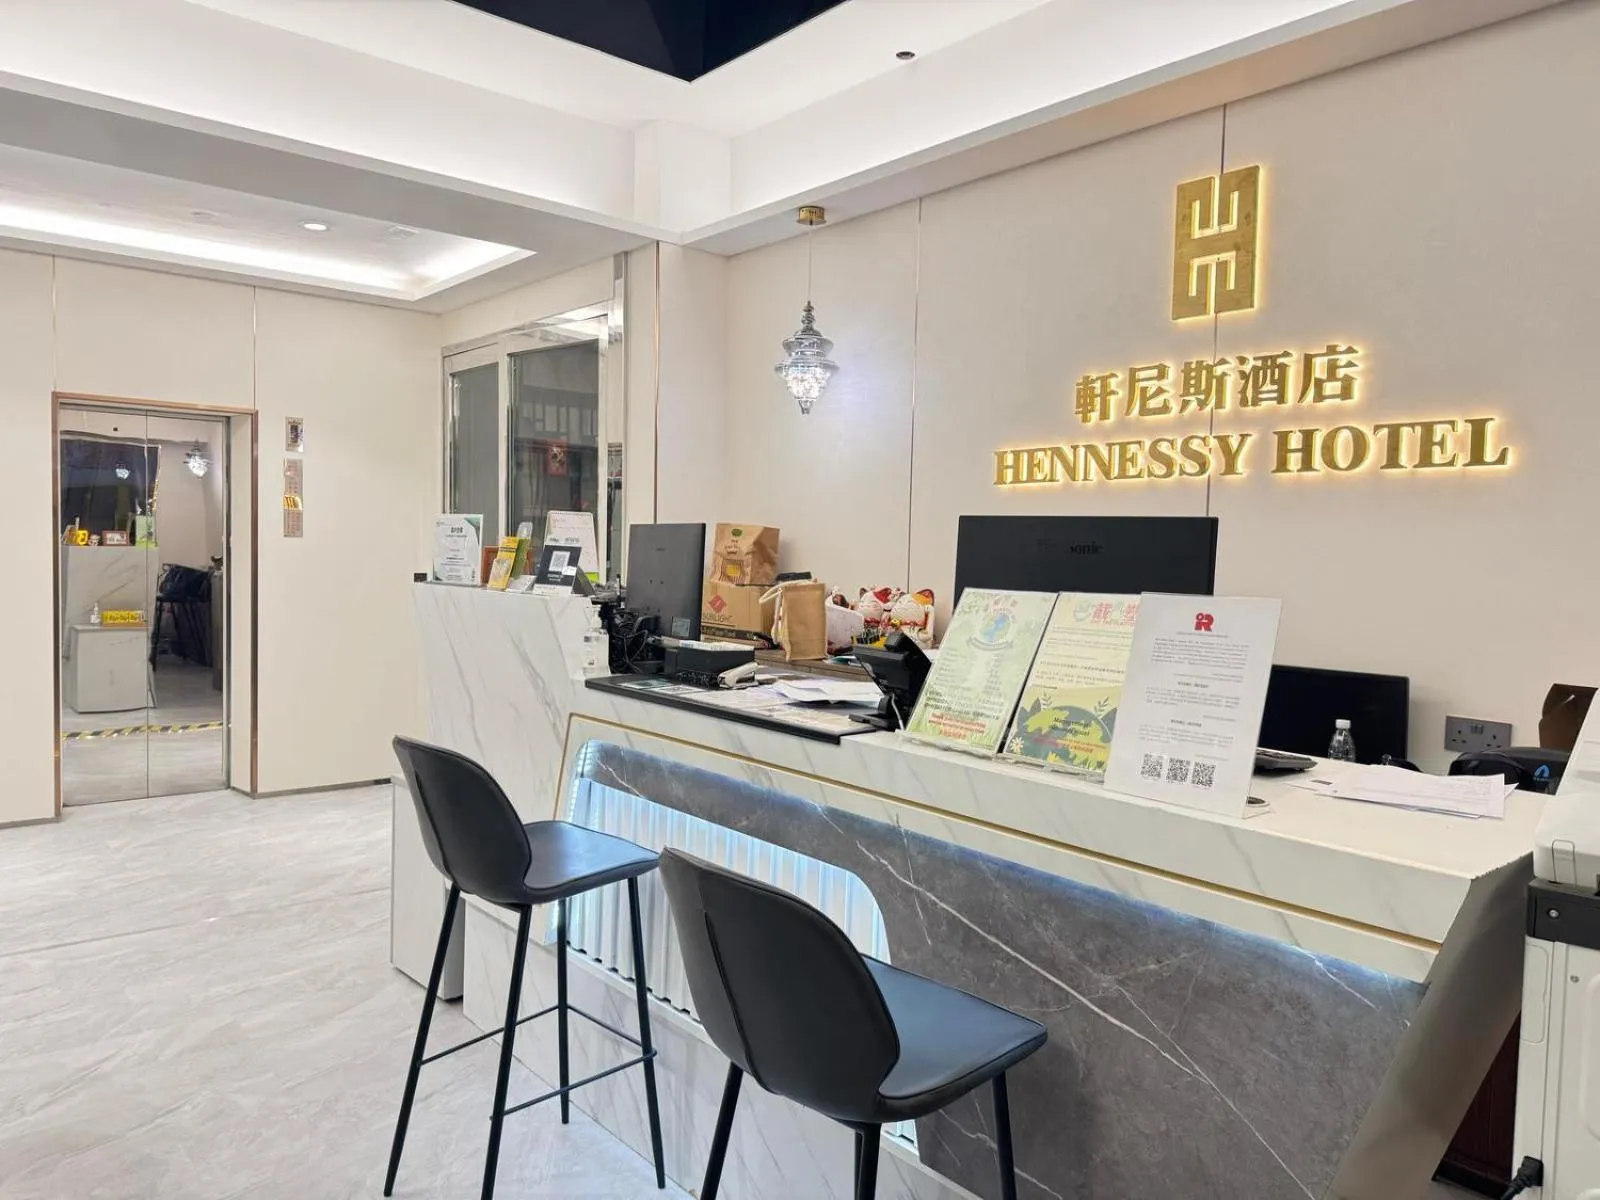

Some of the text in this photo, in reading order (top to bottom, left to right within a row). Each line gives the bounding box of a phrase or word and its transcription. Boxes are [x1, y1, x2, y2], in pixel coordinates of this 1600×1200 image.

[1074, 343, 1360, 424] 軒尼斯酒店
[992, 416, 1510, 486] HENNESSY HOTEL
